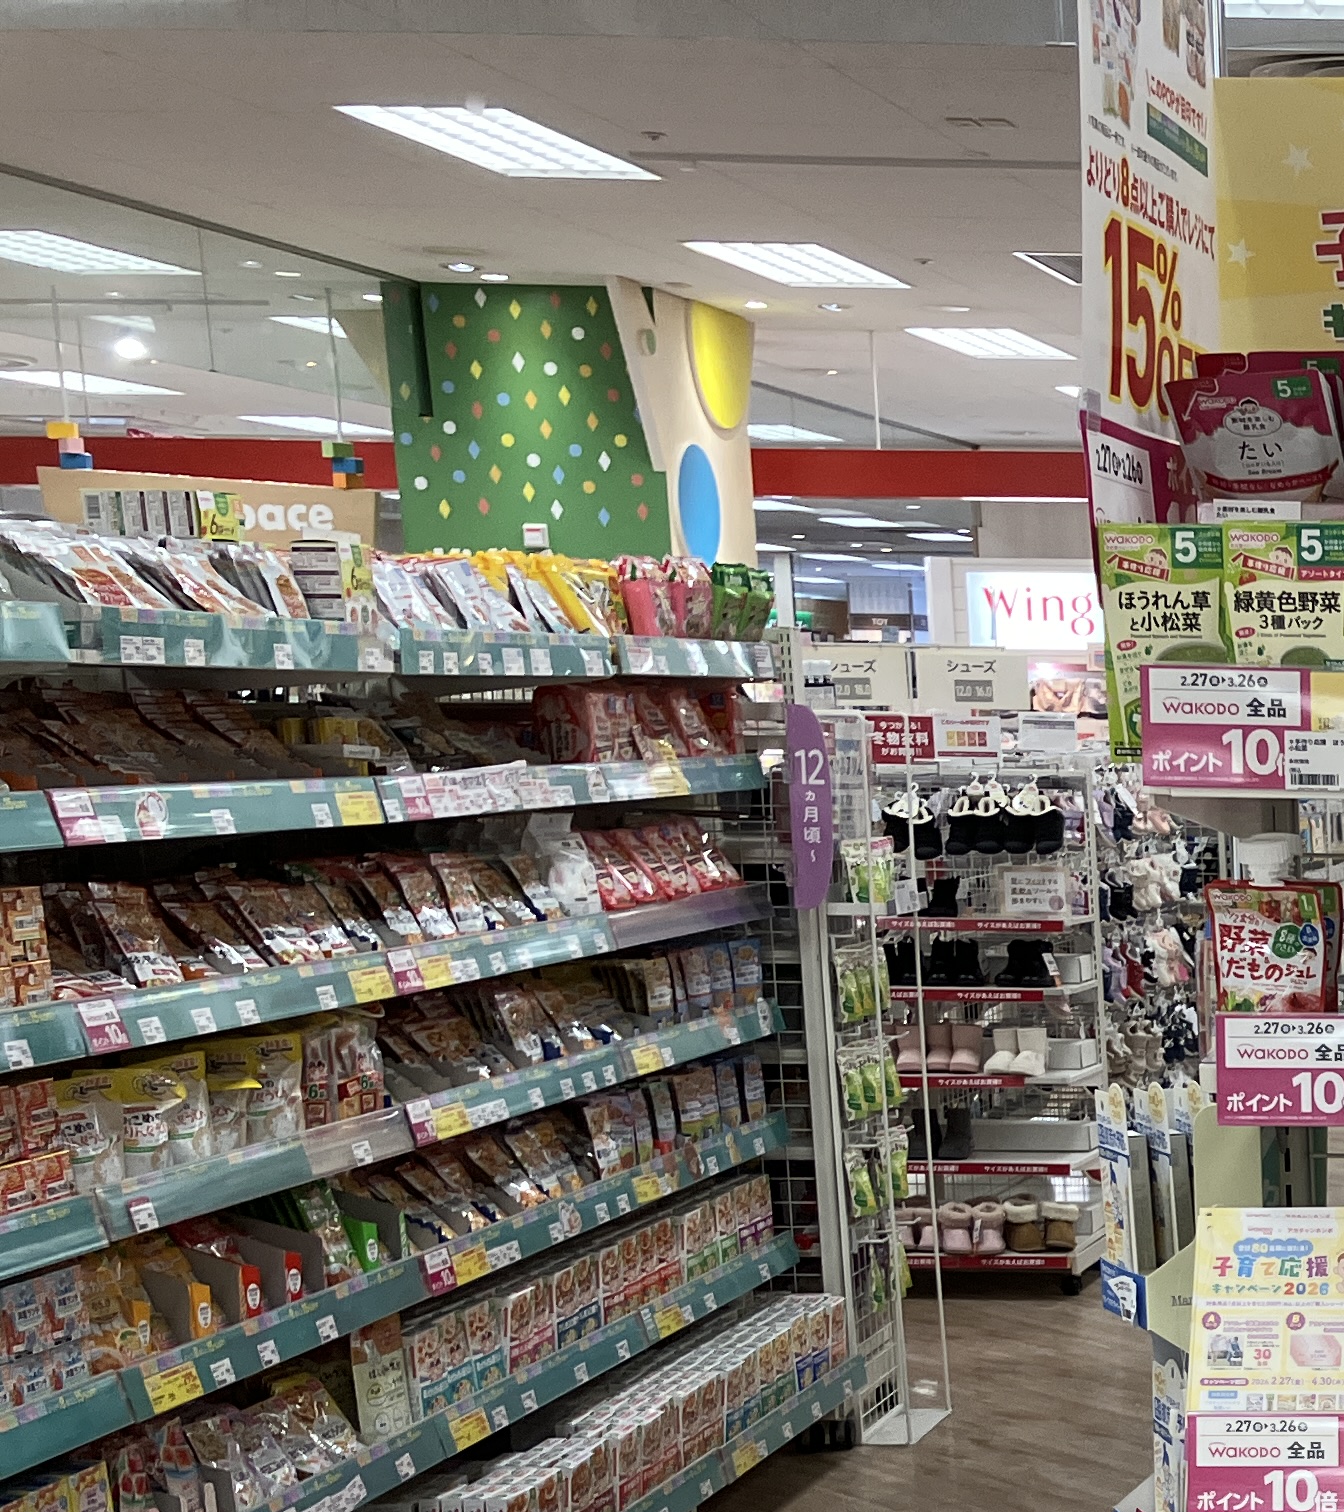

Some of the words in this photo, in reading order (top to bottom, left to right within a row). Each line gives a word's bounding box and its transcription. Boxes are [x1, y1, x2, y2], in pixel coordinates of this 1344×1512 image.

[1238, 441, 1283, 460] たい
[241, 500, 332, 532] pace
[1175, 531, 1196, 563] 5
[1118, 591, 1211, 611] ほうれん草
[1233, 591, 1341, 614] 緑黄色野菜
[982, 587, 1094, 636] Wing
[1129, 612, 1202, 632] と小松菜
[1259, 615, 1324, 631] 3種パック
[947, 660, 996, 674] シューズ
[1246, 698, 1287, 718] 全品
[795, 749, 826, 786] 12
[1211, 1282, 1330, 1296] キャンペーン2026
[1287, 1441, 1325, 1460] 全品
[1197, 1469, 1338, 1512] ポイント10倍
